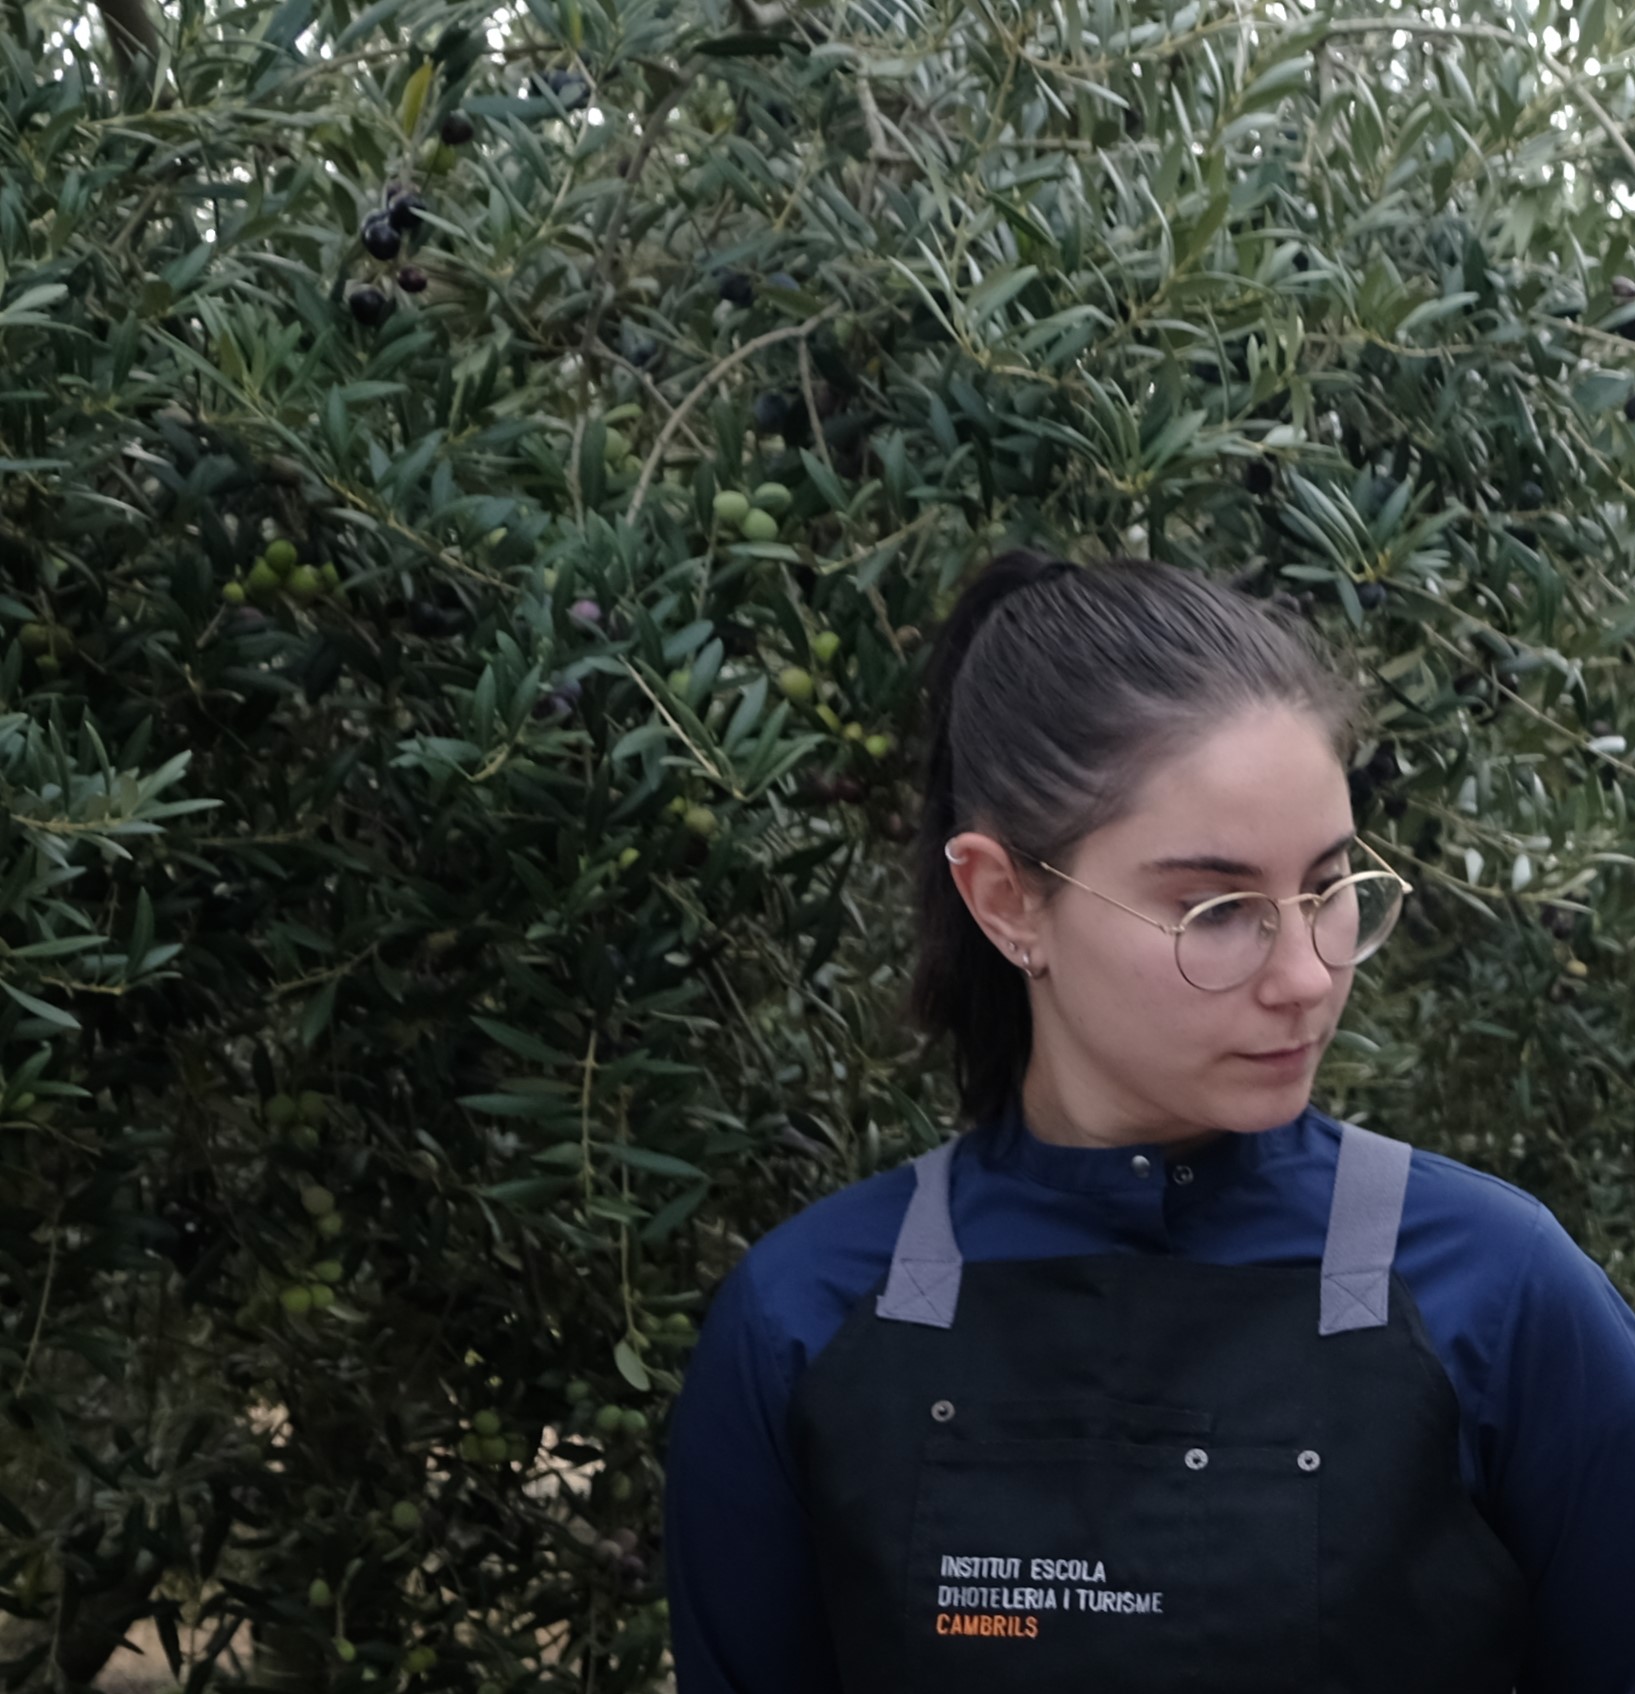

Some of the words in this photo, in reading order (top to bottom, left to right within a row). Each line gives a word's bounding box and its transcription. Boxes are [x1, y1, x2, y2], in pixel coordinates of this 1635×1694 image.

[940, 1555, 1022, 1578] INSTITUT
[1030, 1558, 1106, 1582] ESCOLA
[1063, 1588, 1069, 1610] I
[1075, 1589, 1163, 1613] TURISME
[936, 1613, 1038, 1638] CAMBRILS
